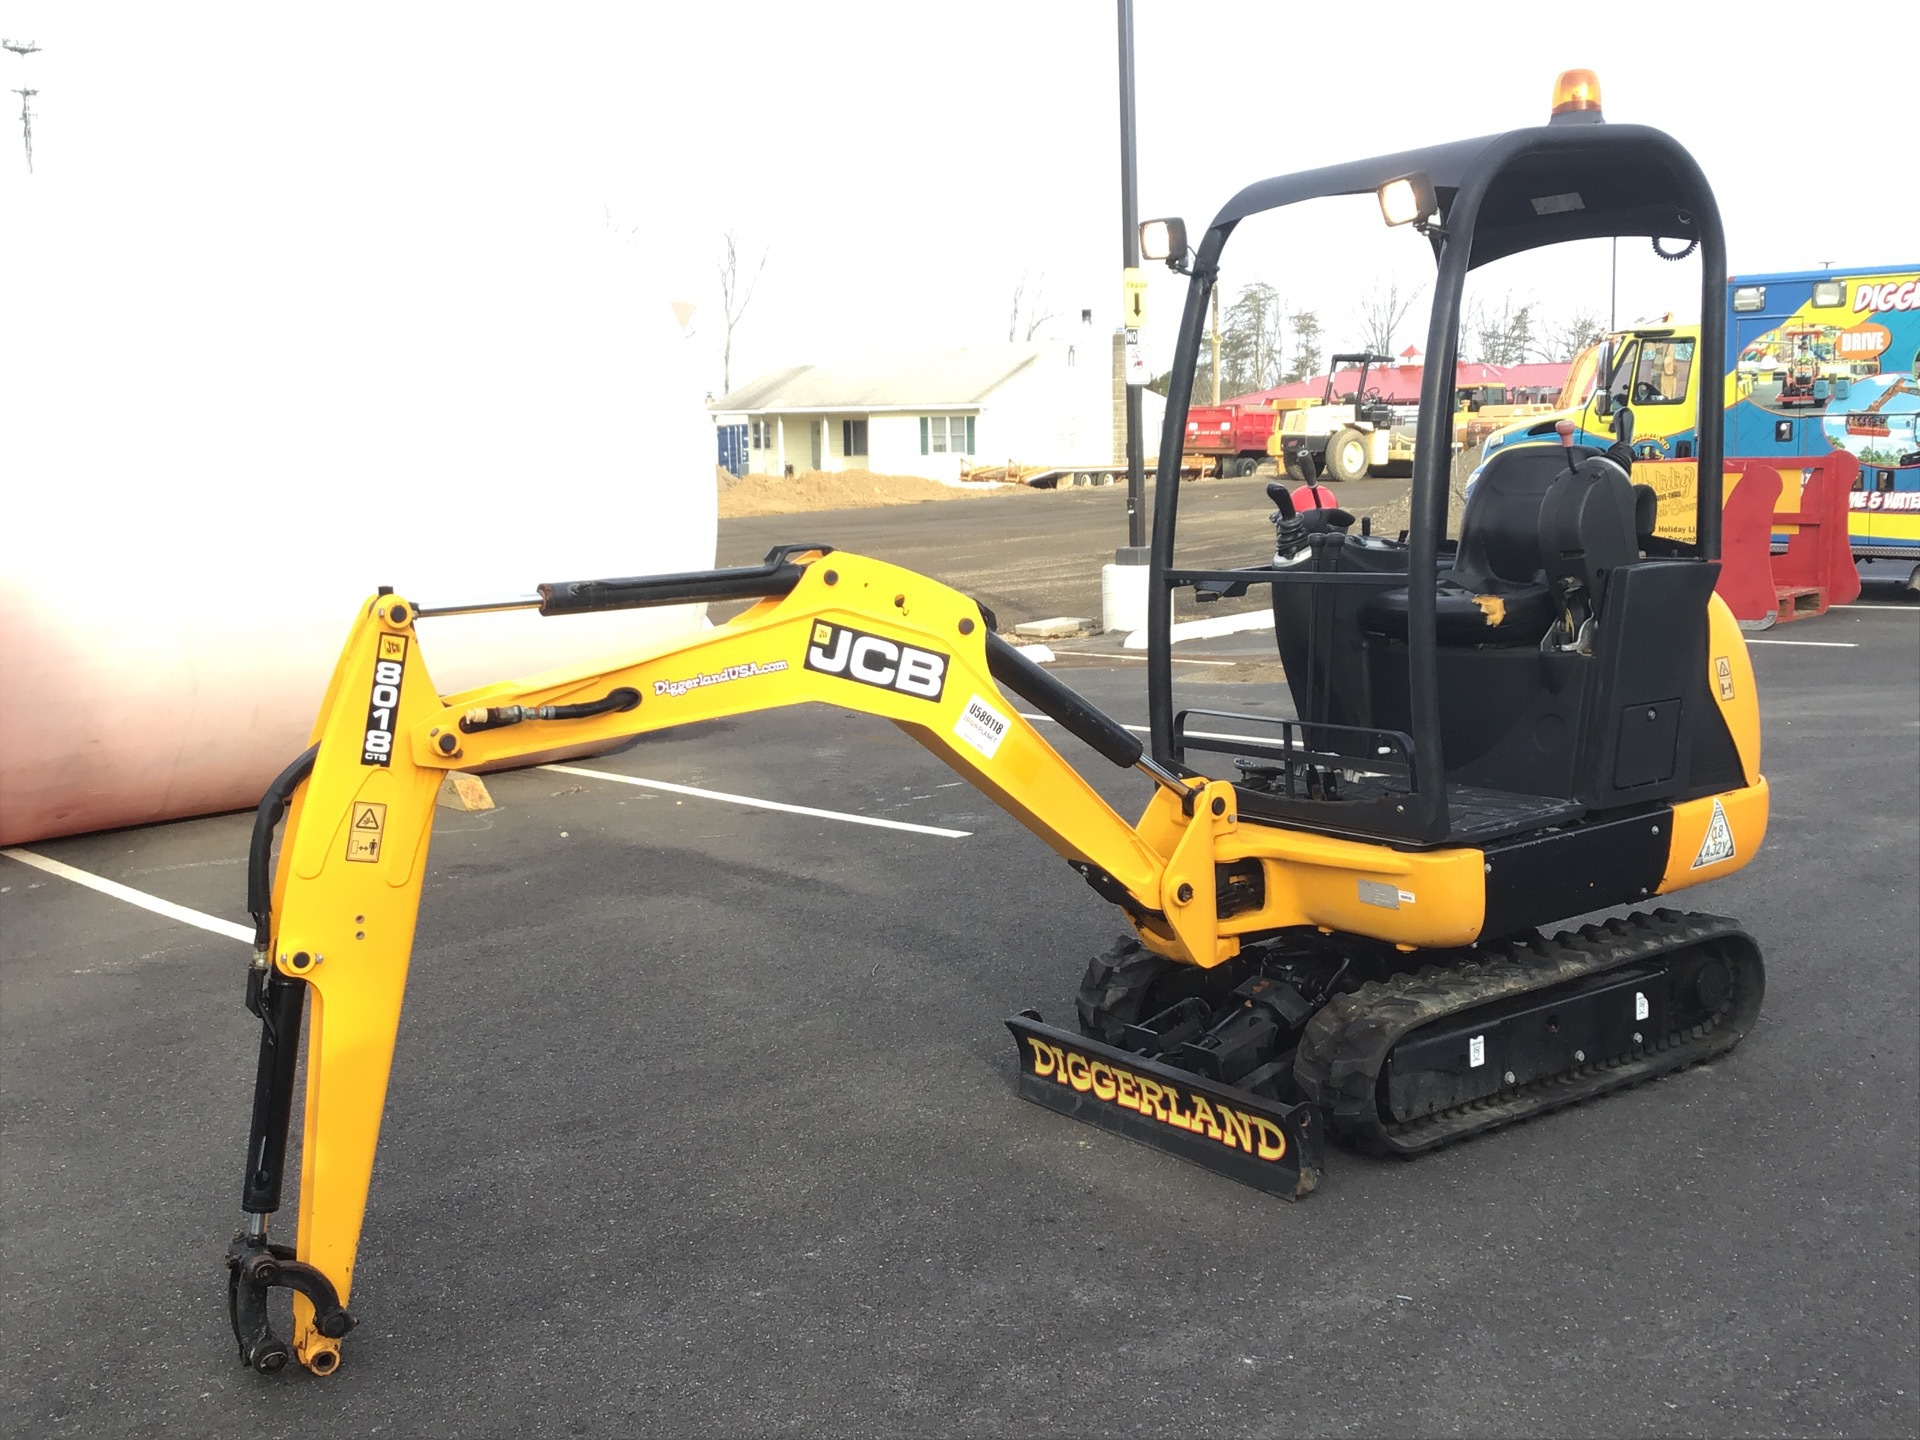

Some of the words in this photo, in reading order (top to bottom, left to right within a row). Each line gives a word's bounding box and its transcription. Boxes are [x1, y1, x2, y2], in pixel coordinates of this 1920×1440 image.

[1841, 331, 1884, 353] DRIVE
[1868, 491, 1883, 509] &
[1658, 526, 1686, 535] Holiday
[653, 659, 788, 697] DiggerlandUSA.com
[809, 629, 945, 697] JCB
[364, 661, 402, 754] 8018
[969, 703, 1004, 735] U589118
[364, 752, 387, 762] CTS
[1027, 1036, 1287, 1161] DIGGERLAND
